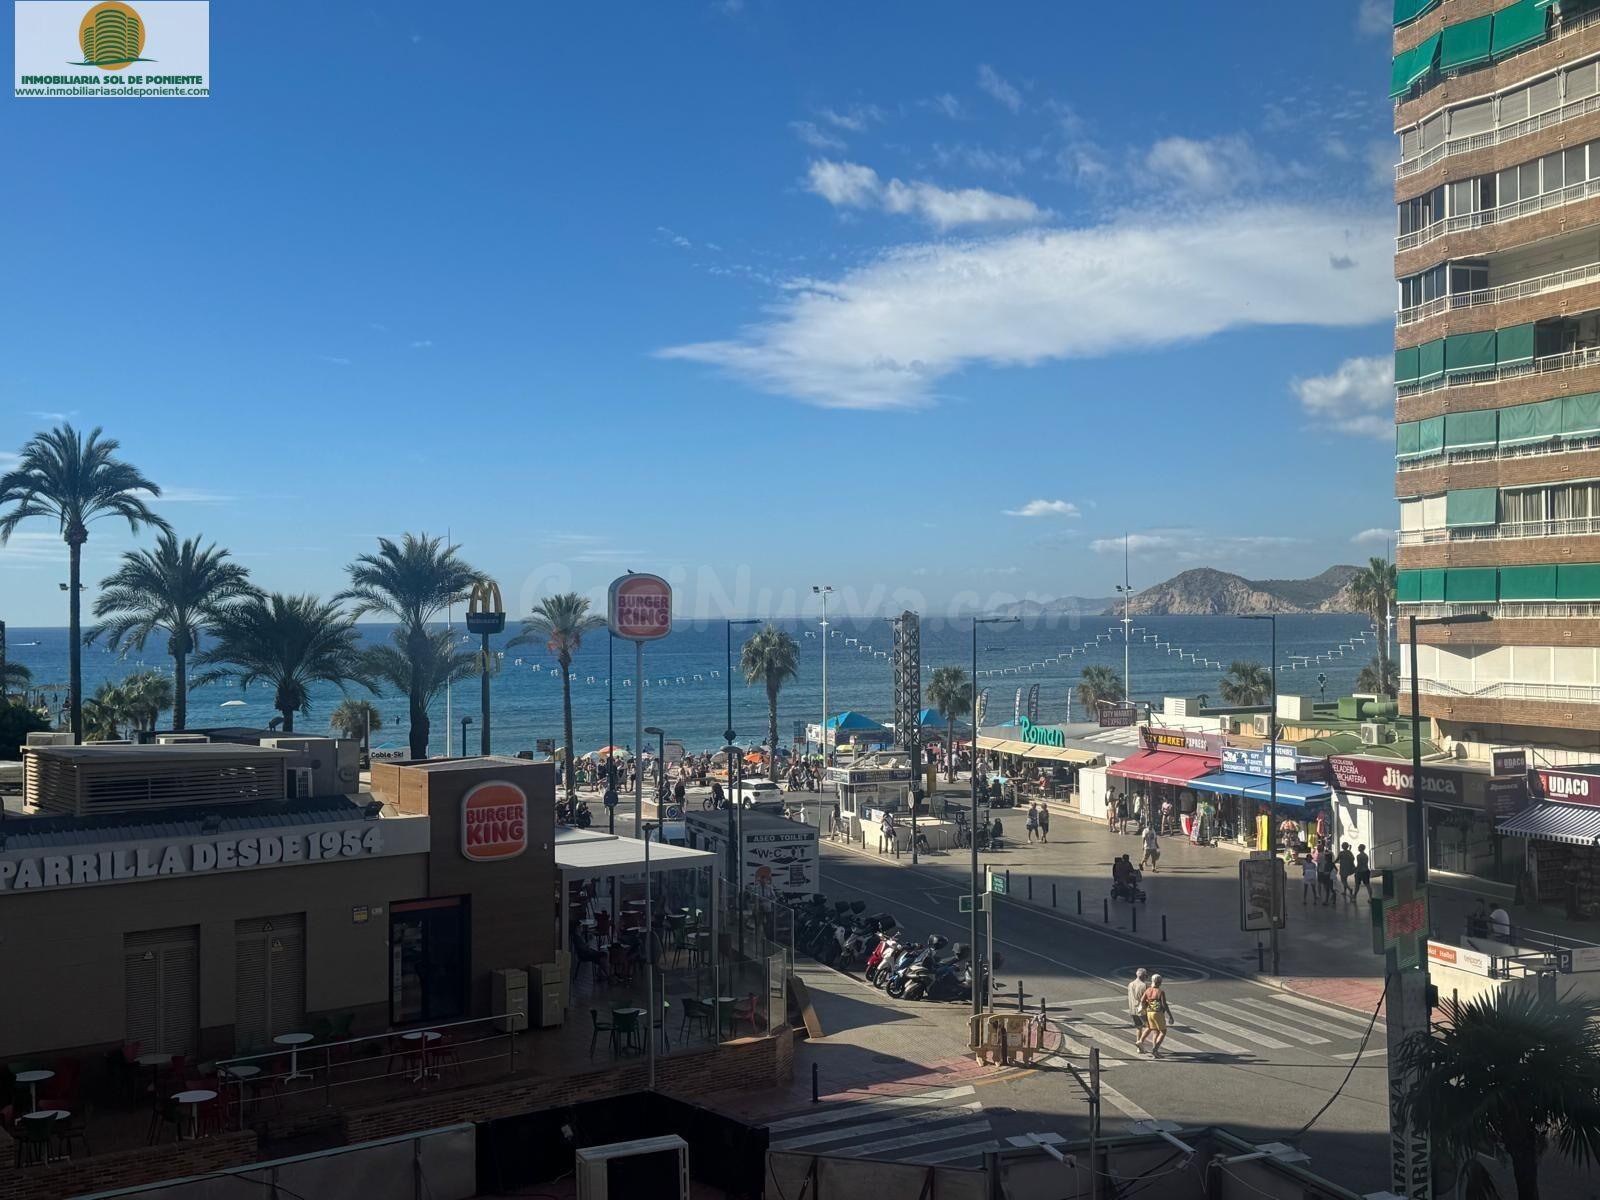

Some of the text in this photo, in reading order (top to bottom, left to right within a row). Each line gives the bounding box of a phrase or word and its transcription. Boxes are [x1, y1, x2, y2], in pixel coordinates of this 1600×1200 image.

[618, 595, 669, 609] BURGER
[618, 608, 669, 626] KING
[1020, 715, 1065, 748] Roman
[1158, 735, 1185, 747] MARKET
[1266, 746, 1294, 756] SVENIRS
[1503, 758, 1525, 767] UDACO
[1548, 775, 1589, 796] UDACO
[466, 805, 524, 825] BURGER
[466, 820, 524, 846] KING
[780, 833, 809, 841] TOILET
[0, 825, 385, 890] PARRILLA DESDE 1954
[1560, 954, 1569, 965] P
